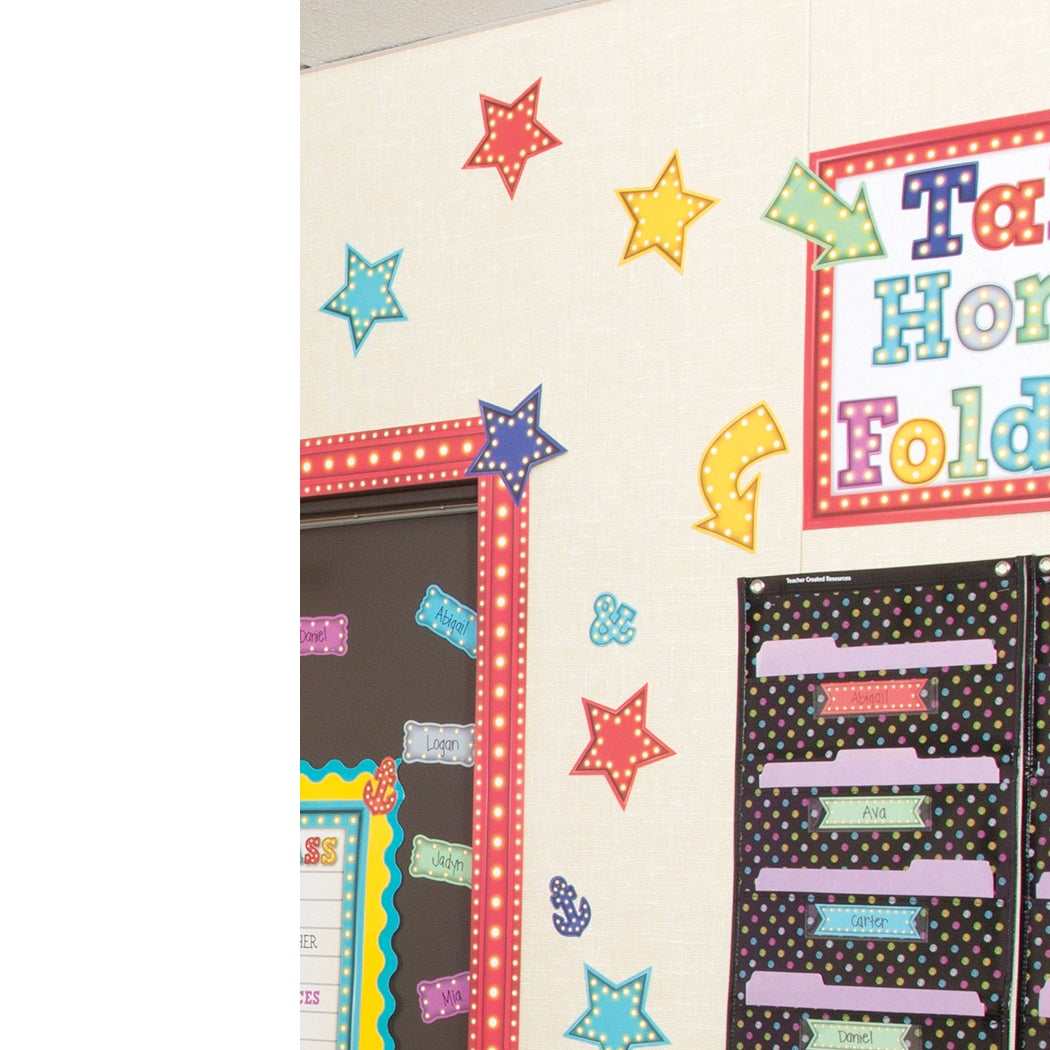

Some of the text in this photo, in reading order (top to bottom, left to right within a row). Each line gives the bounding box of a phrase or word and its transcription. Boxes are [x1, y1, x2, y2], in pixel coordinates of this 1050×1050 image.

[435, 606, 469, 636] Abigail
[300, 627, 327, 644] Daniel
[426, 734, 460, 758] Logan
[862, 805, 887, 819] Ava
[300, 837, 338, 865] SS
[432, 850, 465, 874] Jadyn
[851, 914, 888, 928] Carter
[442, 988, 463, 1007] Mia
[838, 1030, 873, 1045] Daniel
